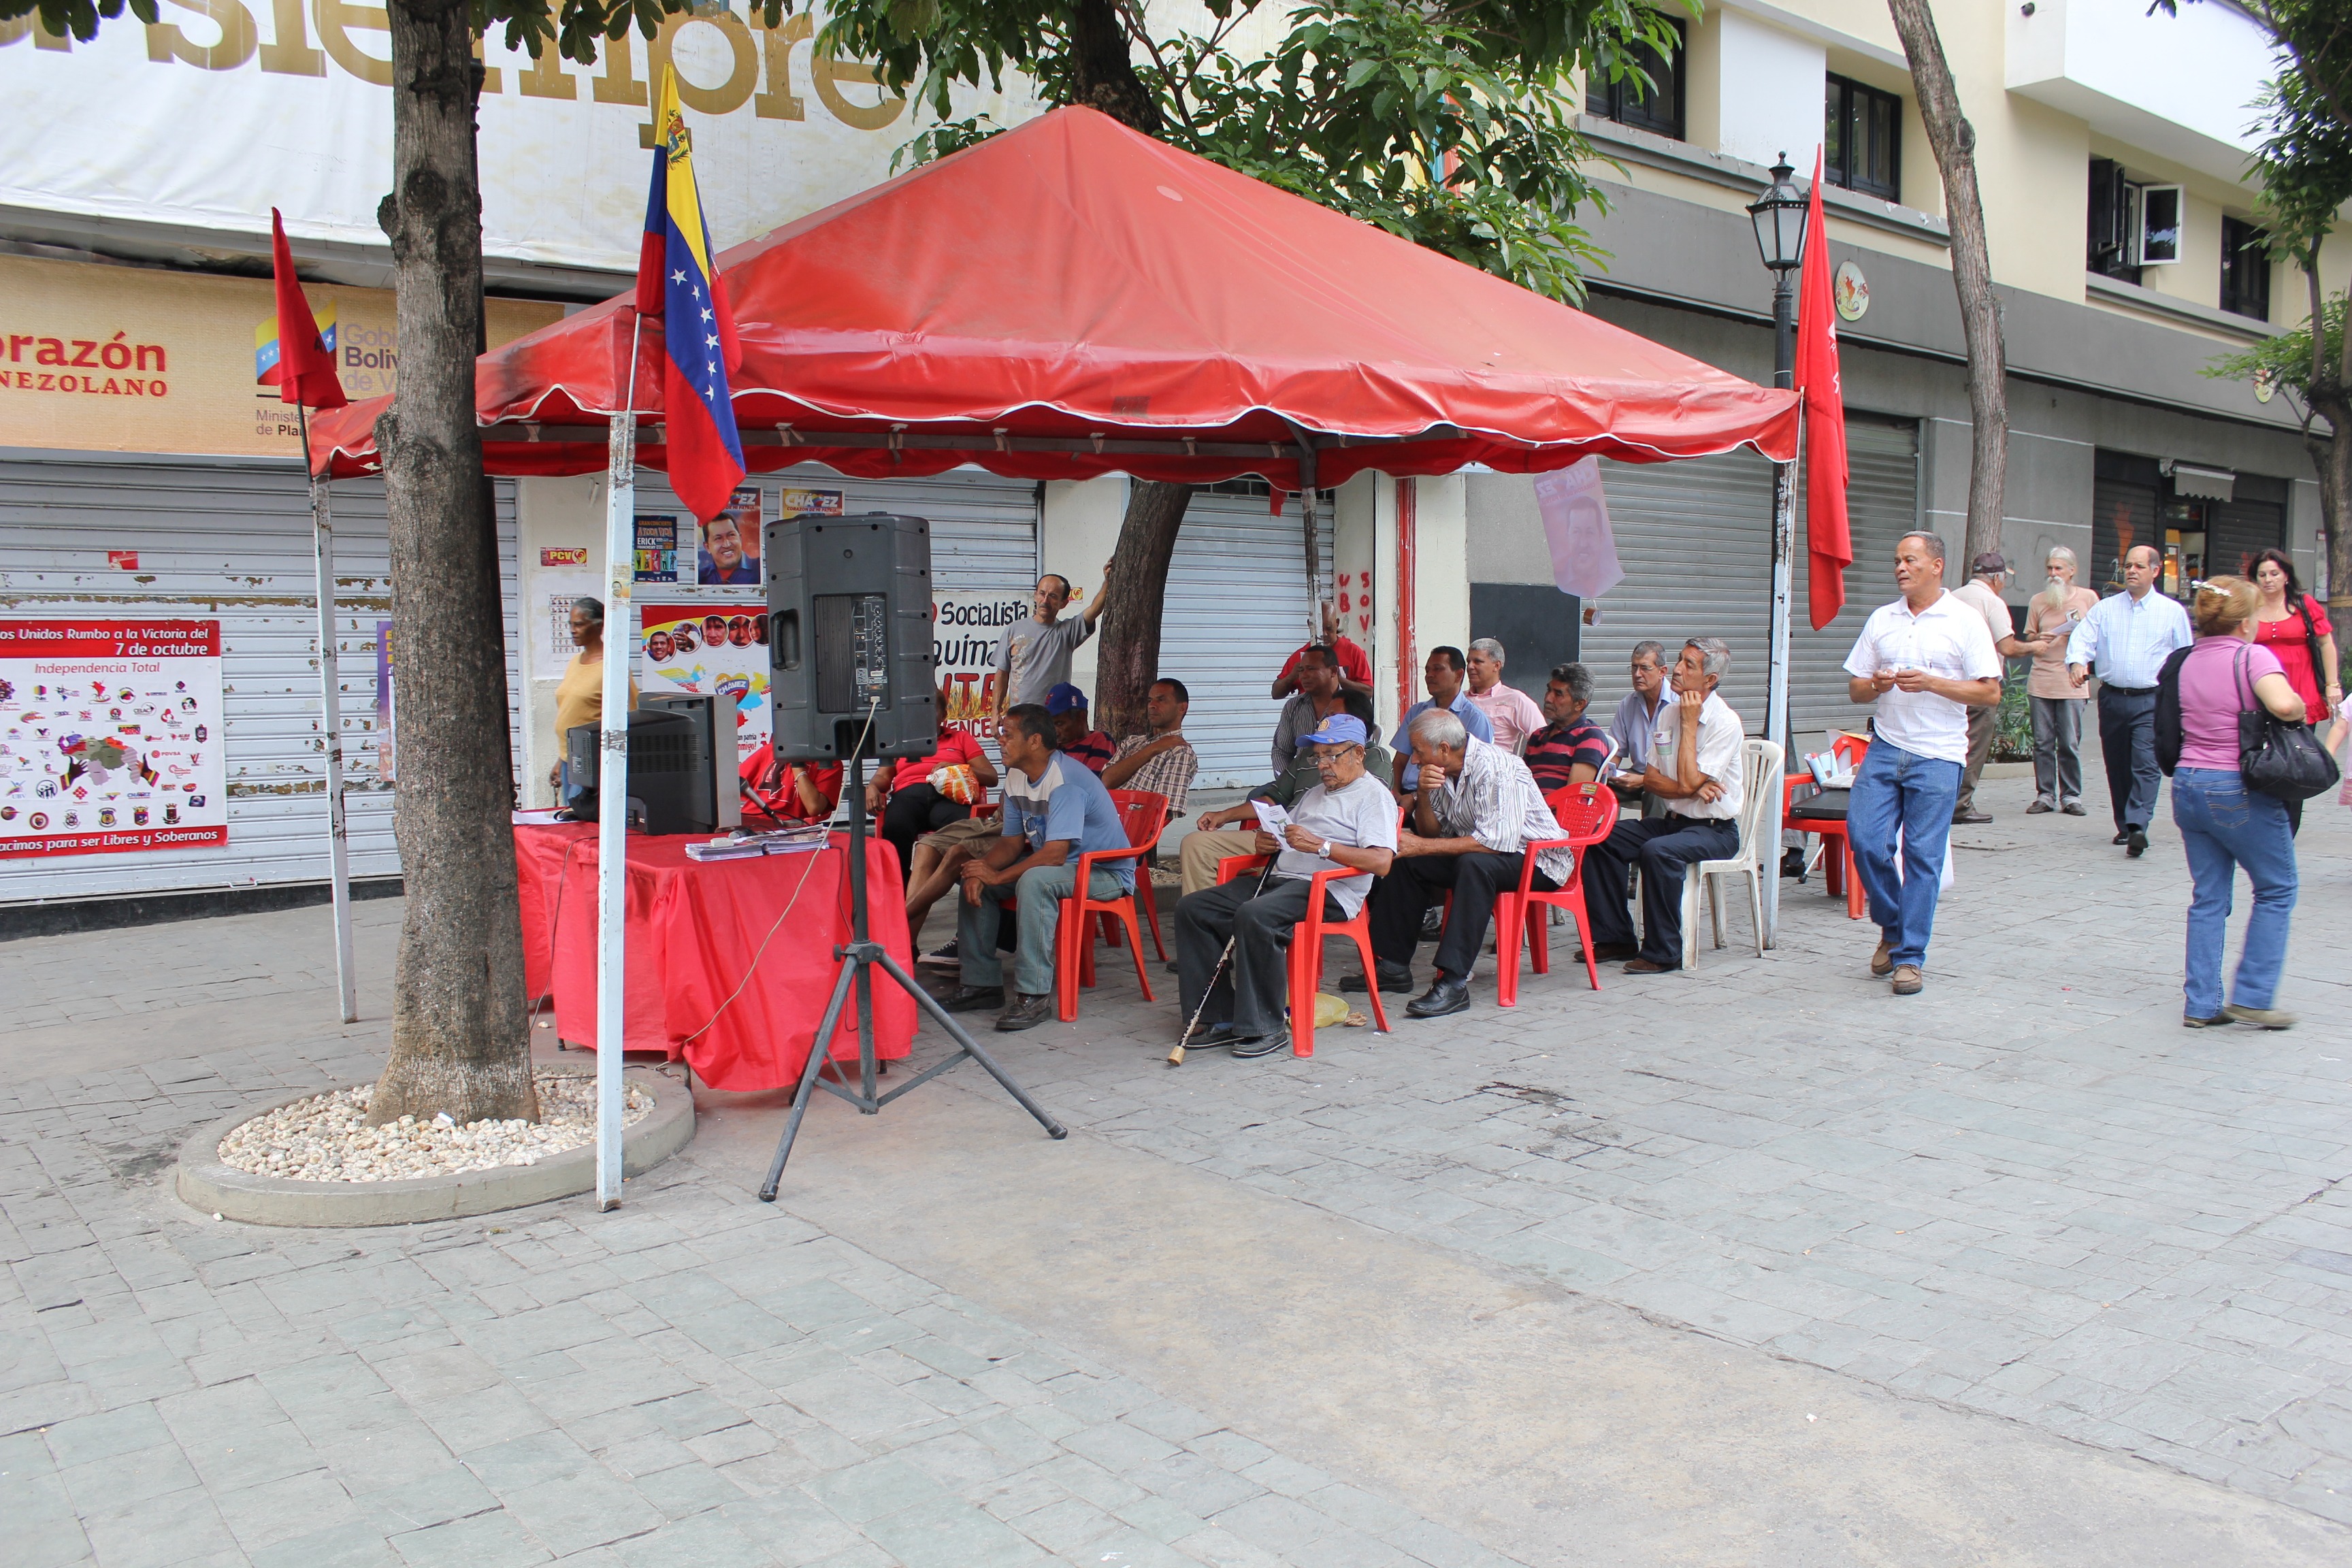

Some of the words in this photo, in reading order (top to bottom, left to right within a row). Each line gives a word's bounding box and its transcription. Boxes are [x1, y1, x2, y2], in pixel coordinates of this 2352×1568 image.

[0, 330, 167, 372] razón
[344, 371, 372, 391] de
[257, 423, 273, 436] de
[550, 551, 571, 560] PCV
[19, 628, 64, 640] Unidos
[68, 628, 111, 640] Rumbo
[114, 631, 123, 640] a
[126, 629, 139, 640] la
[142, 628, 187, 640] Victoria
[190, 628, 209, 639] del
[115, 642, 125, 655] 7
[129, 642, 148, 655] de
[152, 642, 208, 655] octubre
[35, 663, 127, 676] Independencia
[131, 662, 161, 673] Total
[744, 733, 757, 742] patria
[47, 839, 78, 852] para
[80, 838, 100, 847] ser
[103, 834, 140, 847] Libres
[143, 835, 151, 847] y
[154, 830, 218, 843] Soberanos
